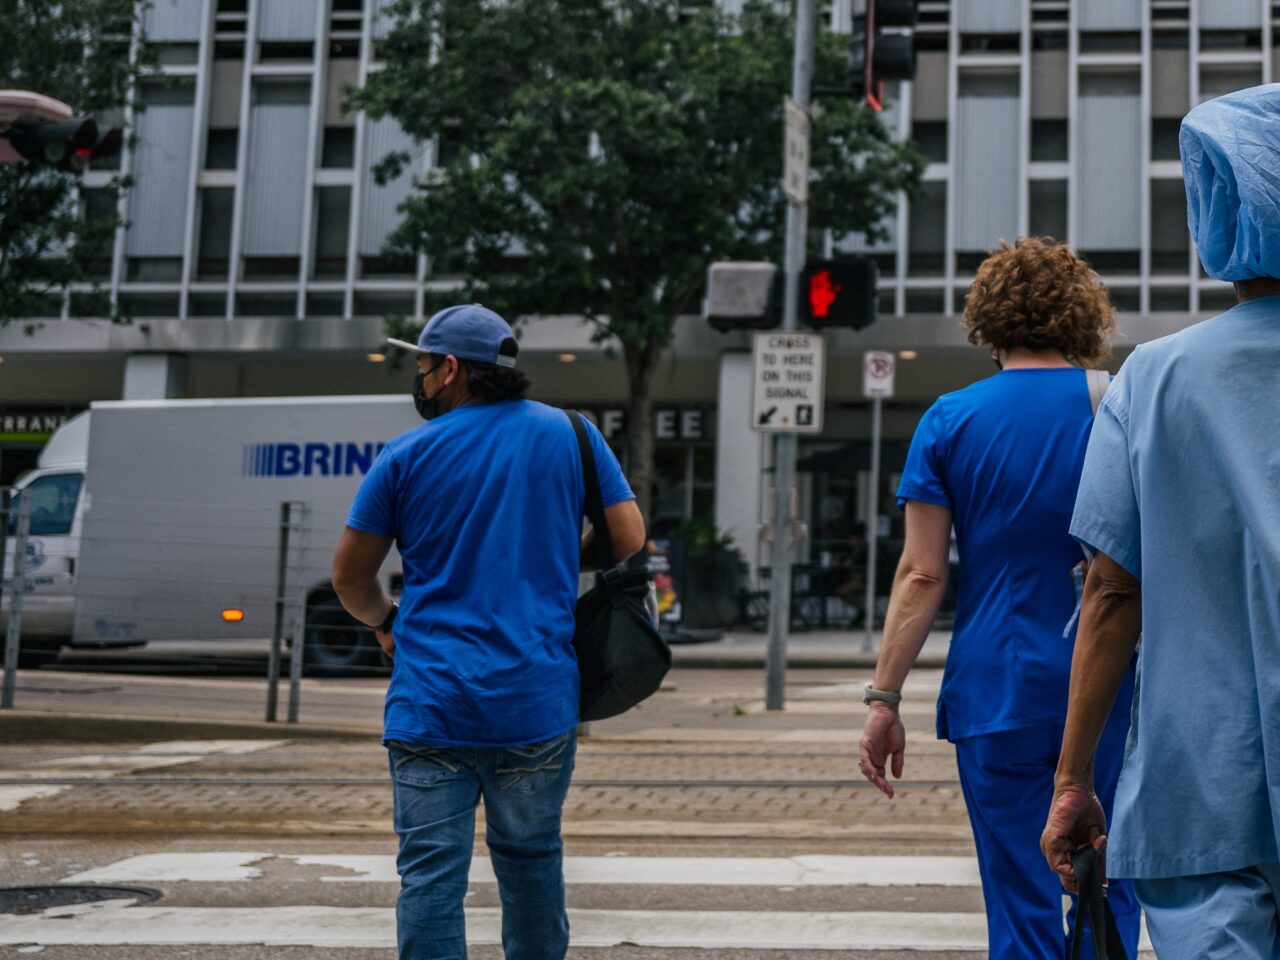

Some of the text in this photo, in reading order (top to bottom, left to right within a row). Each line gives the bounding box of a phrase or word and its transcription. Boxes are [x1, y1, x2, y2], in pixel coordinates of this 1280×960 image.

[769, 336, 810, 349] CROSS
[763, 353, 815, 366] TO HERE
[763, 370, 813, 383] ON THIS
[766, 387, 808, 399] SIGNAL
[274, 442, 386, 476] BRIN
